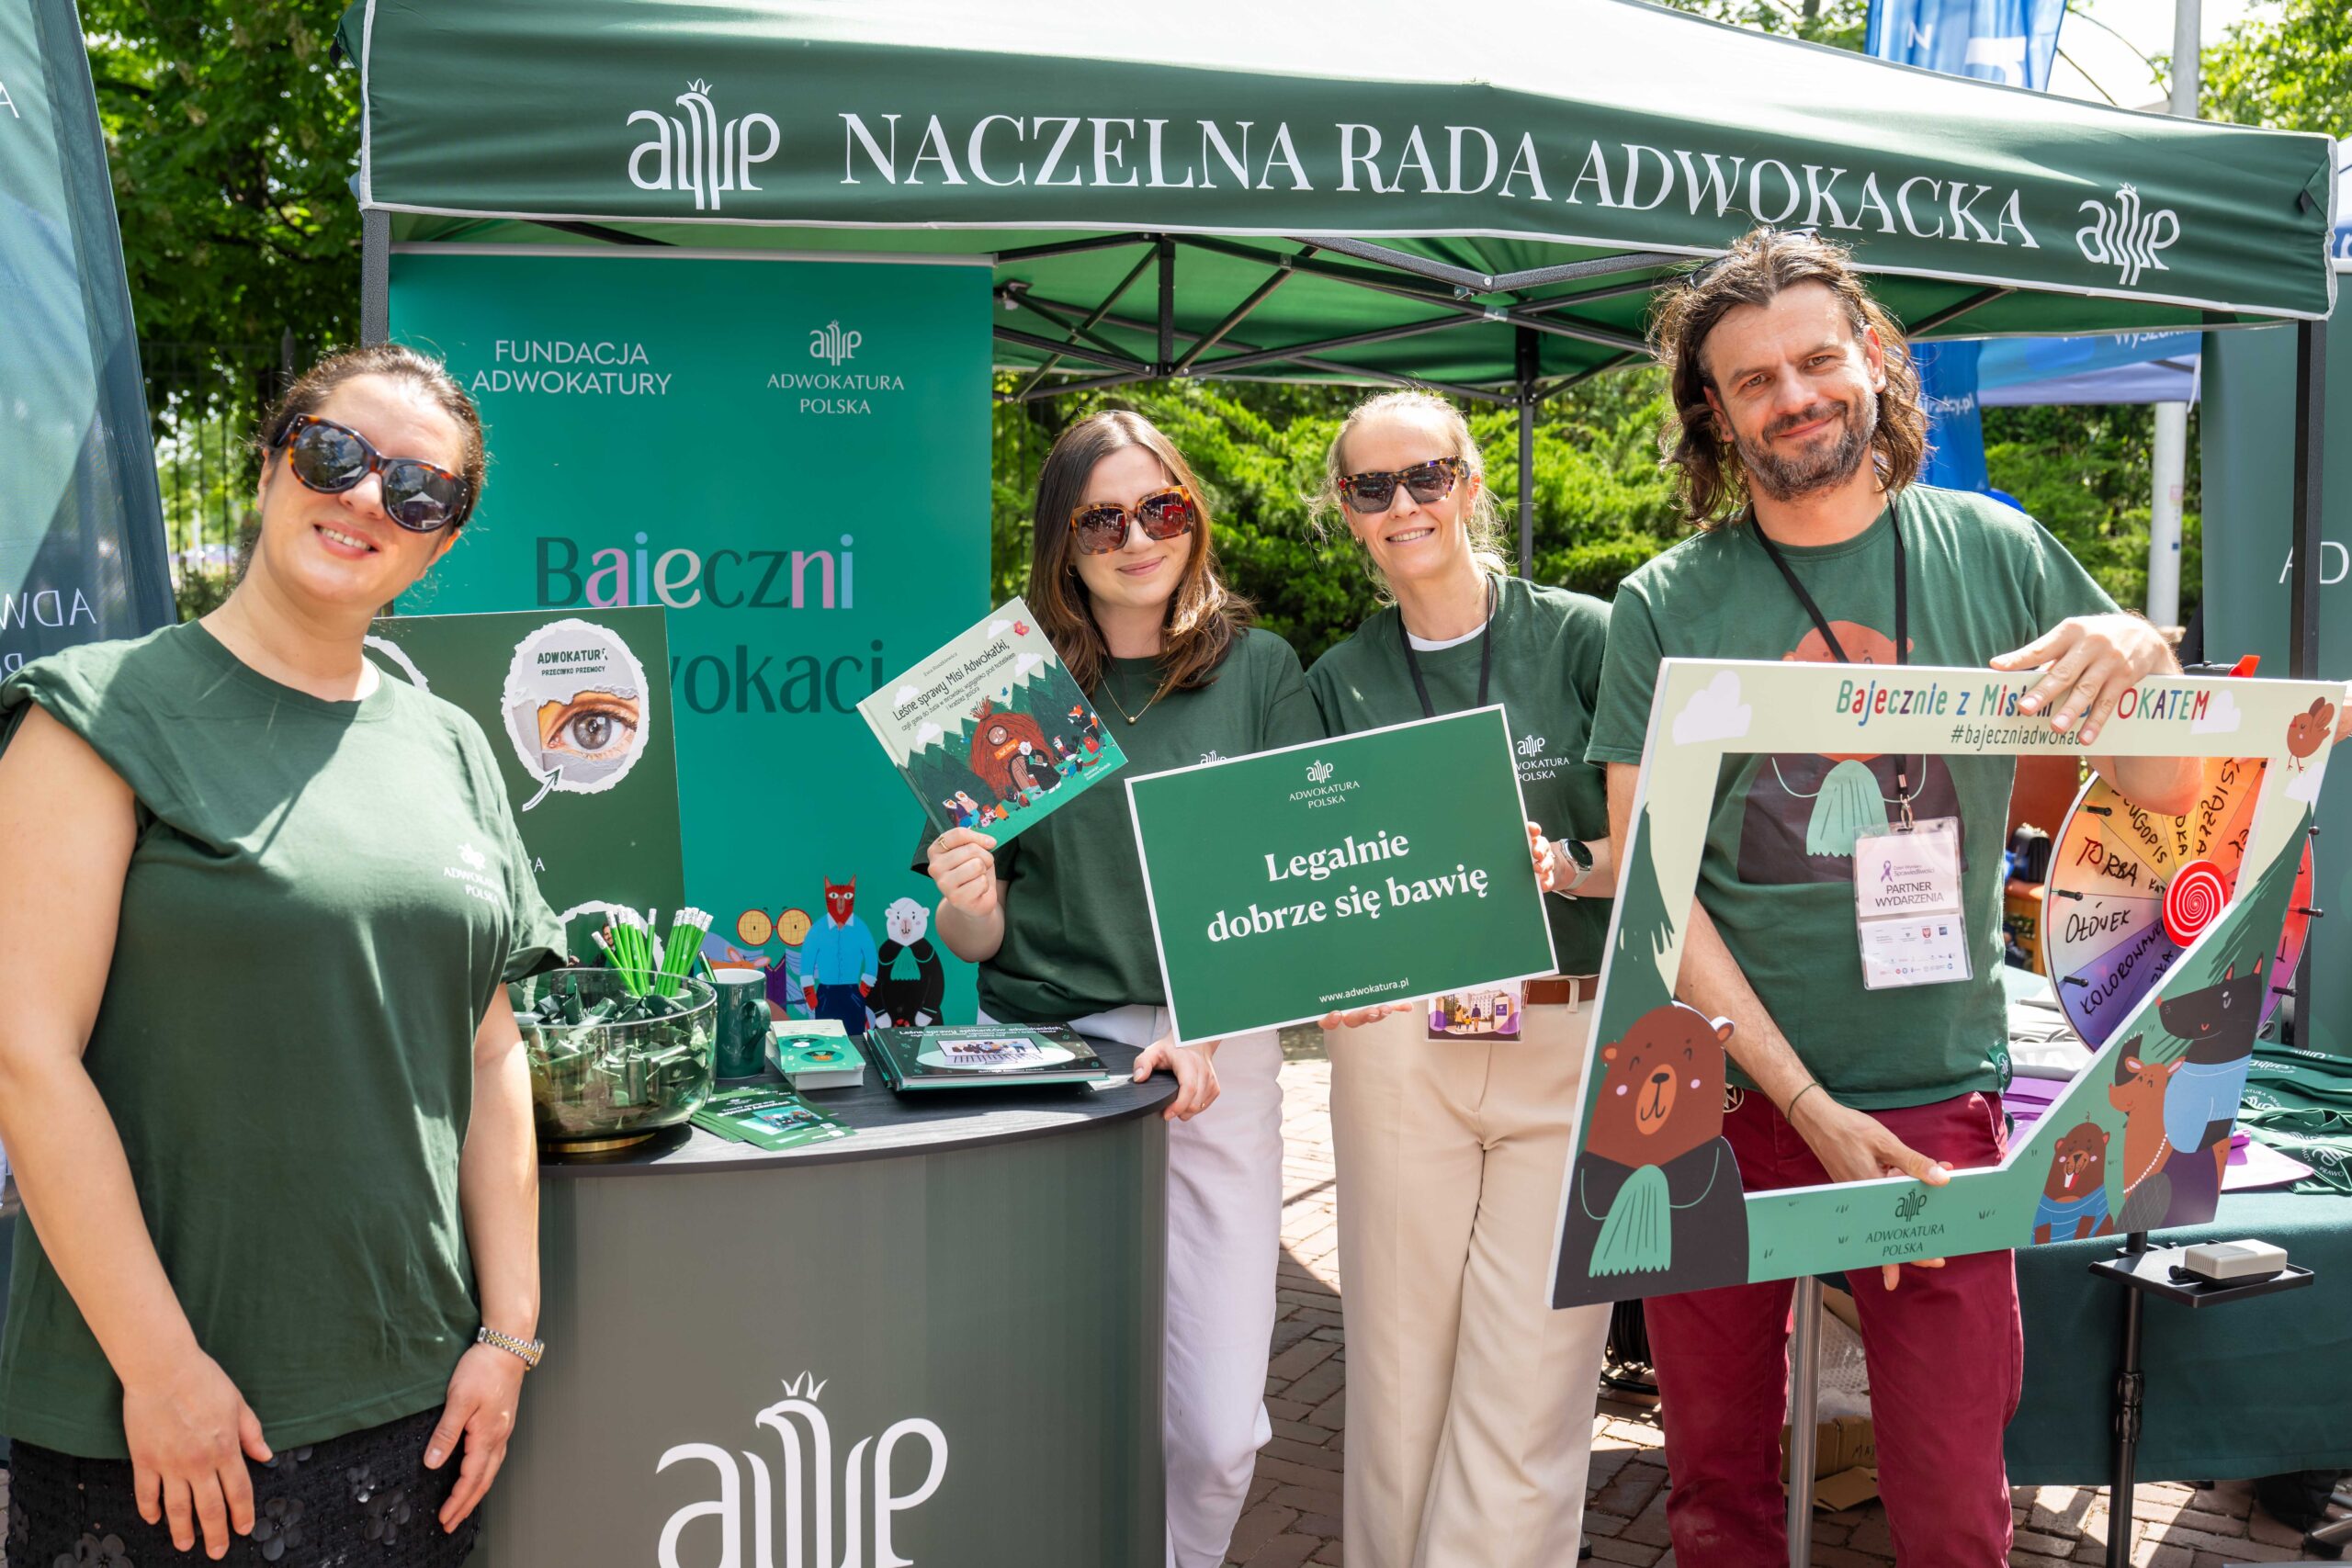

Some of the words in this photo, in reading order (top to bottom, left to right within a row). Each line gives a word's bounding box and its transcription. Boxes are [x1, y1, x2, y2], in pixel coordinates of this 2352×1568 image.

[839, 112, 1314, 191] NACZELNA
[1336, 123, 1551, 196] RADA
[1566, 139, 2041, 250] ADWOKACKA
[495, 340, 649, 366] FUNDACJA
[471, 370, 672, 396] ADWOKATURY
[767, 374, 905, 390] ADWOKATURA
[800, 399, 871, 414] POLSKA
[541, 667, 574, 676] PRZECIWKO
[575, 666, 605, 674] PRZEMOCY
[892, 701, 919, 721] Leśne
[917, 681, 950, 706] sprawy
[945, 668, 965, 686] Misi
[963, 639, 1011, 675] Adwokatki,
[1837, 680, 1947, 726] Bajecznie
[1955, 691, 1971, 716] z
[1289, 780, 1360, 802] ADWOKATURA
[1308, 795, 1345, 809] POLSKA
[1264, 830, 1410, 882] Legalnie
[2076, 837, 2138, 886] TORBA
[1875, 893, 1944, 907] WYDARZENIA
[1886, 882, 1932, 895] PARTNER
[1207, 899, 1328, 942] dobrze
[1335, 886, 1381, 919] się
[1389, 863, 1489, 908] bawię
[2080, 920, 2165, 1015] KOLOROWANK
[1319, 978, 1409, 1003] www.adwokatura.pl
[1865, 1224, 1945, 1244] ADWOKATURA
[1882, 1242, 1923, 1257] POLSKA
